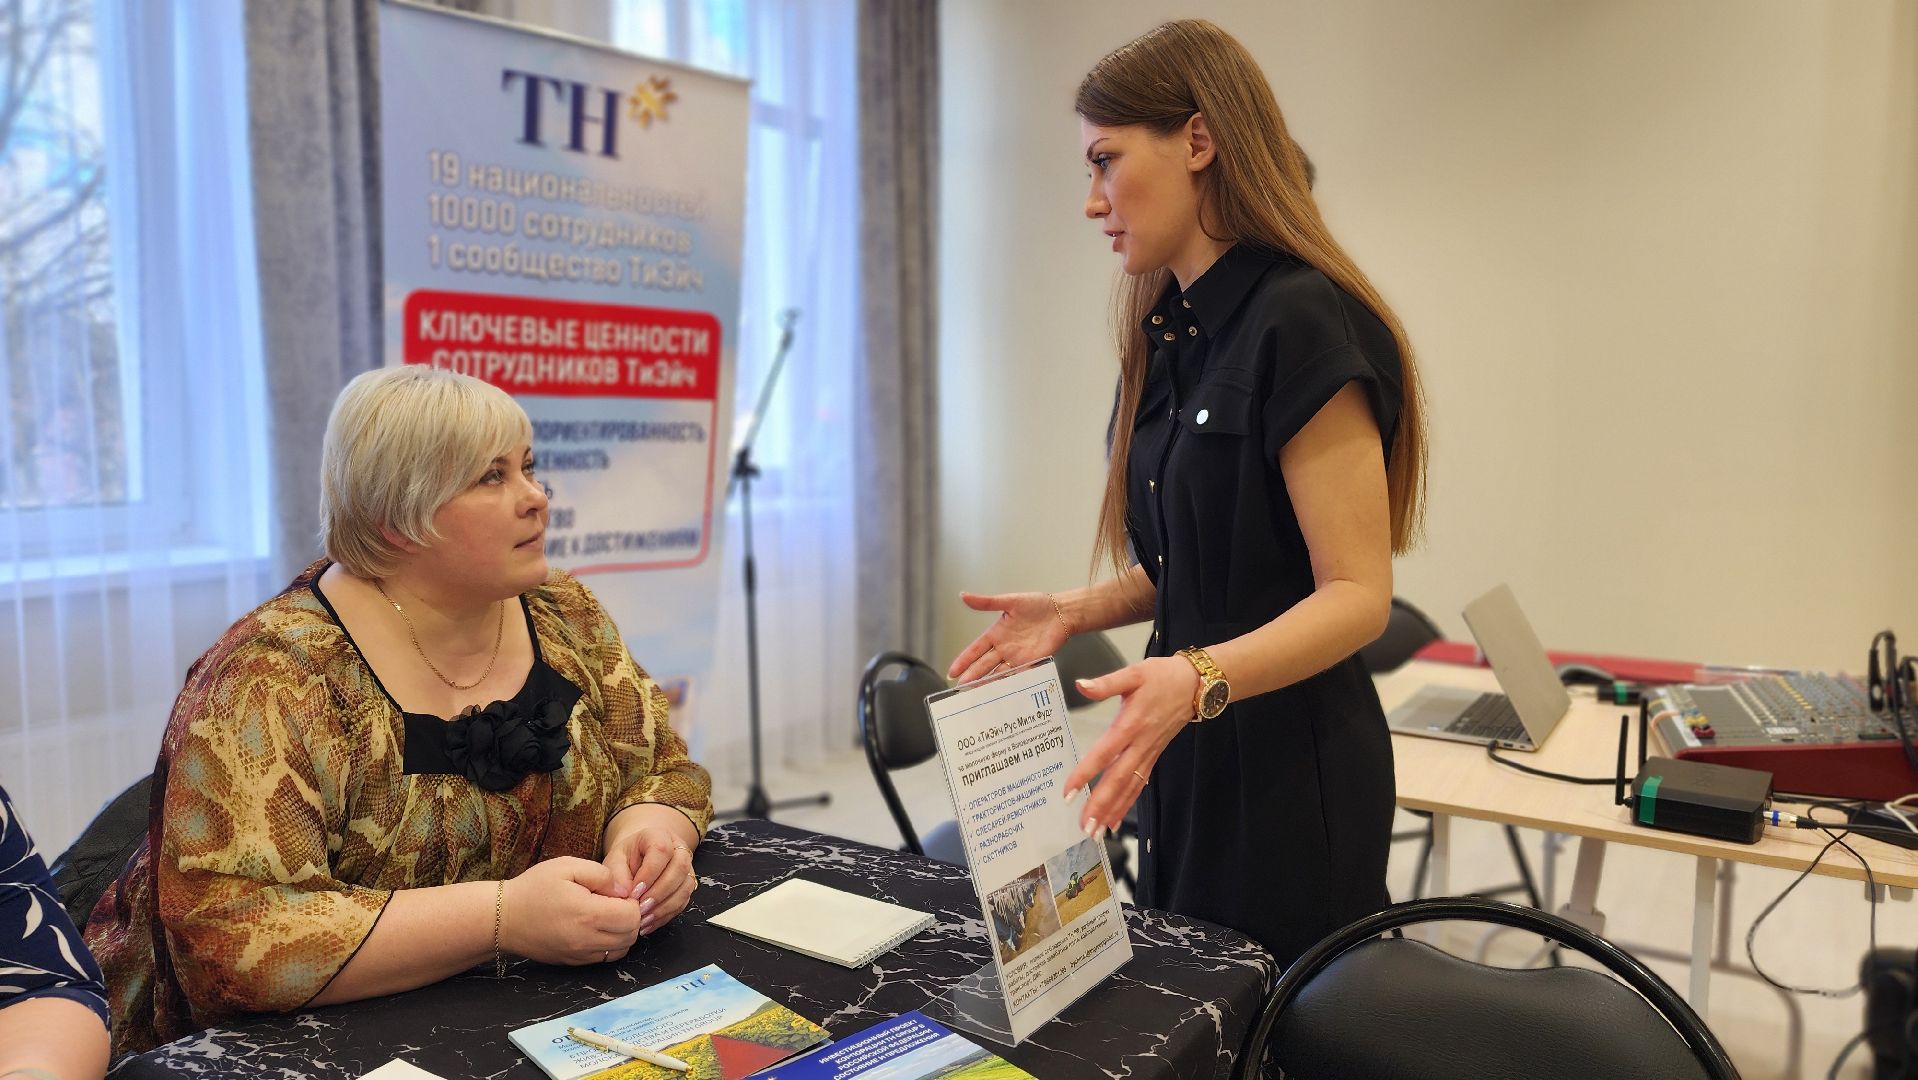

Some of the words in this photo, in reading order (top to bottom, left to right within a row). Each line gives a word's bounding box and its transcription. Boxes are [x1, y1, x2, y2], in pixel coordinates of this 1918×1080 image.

[501, 68, 623, 160] TH
[427, 149, 460, 186] 19
[428, 193, 516, 236] 10000
[522, 209, 691, 255] сотрудников
[427, 234, 441, 269] 1
[448, 241, 622, 286] сообщество
[628, 255, 705, 292] ТиЭйч
[419, 309, 577, 348] КЛЮЧЕВЫЕ
[584, 320, 709, 356] ЦЕННОСТИ
[432, 349, 618, 385] СОТРУДНИКОВ
[626, 359, 698, 389] ТиЭйч
[957, 735, 976, 750] ООО
[1003, 721, 1018, 734] Рус
[1017, 713, 1036, 726] Милк
[962, 753, 1022, 788] приглашаем
[1022, 748, 1033, 759] на
[1034, 732, 1065, 757] работу
[968, 787, 1006, 809] ОПЕРАТОРОВ
[1006, 771, 1041, 792] МАШИННОГО
[971, 780, 1054, 823] ТРАКТОРИСТОВ-МАШИНИСТОВ
[975, 796, 1047, 836] СЛЕСАРЕЙ-РЕМОНТНИКОВ
[979, 822, 1024, 849] РАЗНОРАБОЧИХ
[982, 840, 1017, 864] СКОТНИКОВ
[552, 1026, 597, 1043] ОТТ
[819, 1027, 891, 1064] ИНВЕСТИЦИОННЫЙ
[890, 1019, 918, 1035] ПРОЕКТ
[835, 1039, 883, 1064] КОРПОРАЦИИ
[838, 1045, 889, 1071] РОССИЙСКОЙ
[888, 1028, 933, 1049] ФЕДЕРАЦИИ
[833, 1056, 880, 1080] СОСТОЯНИЕ
[886, 1032, 940, 1058] ПРЕДЛОЖЕНИЯ
